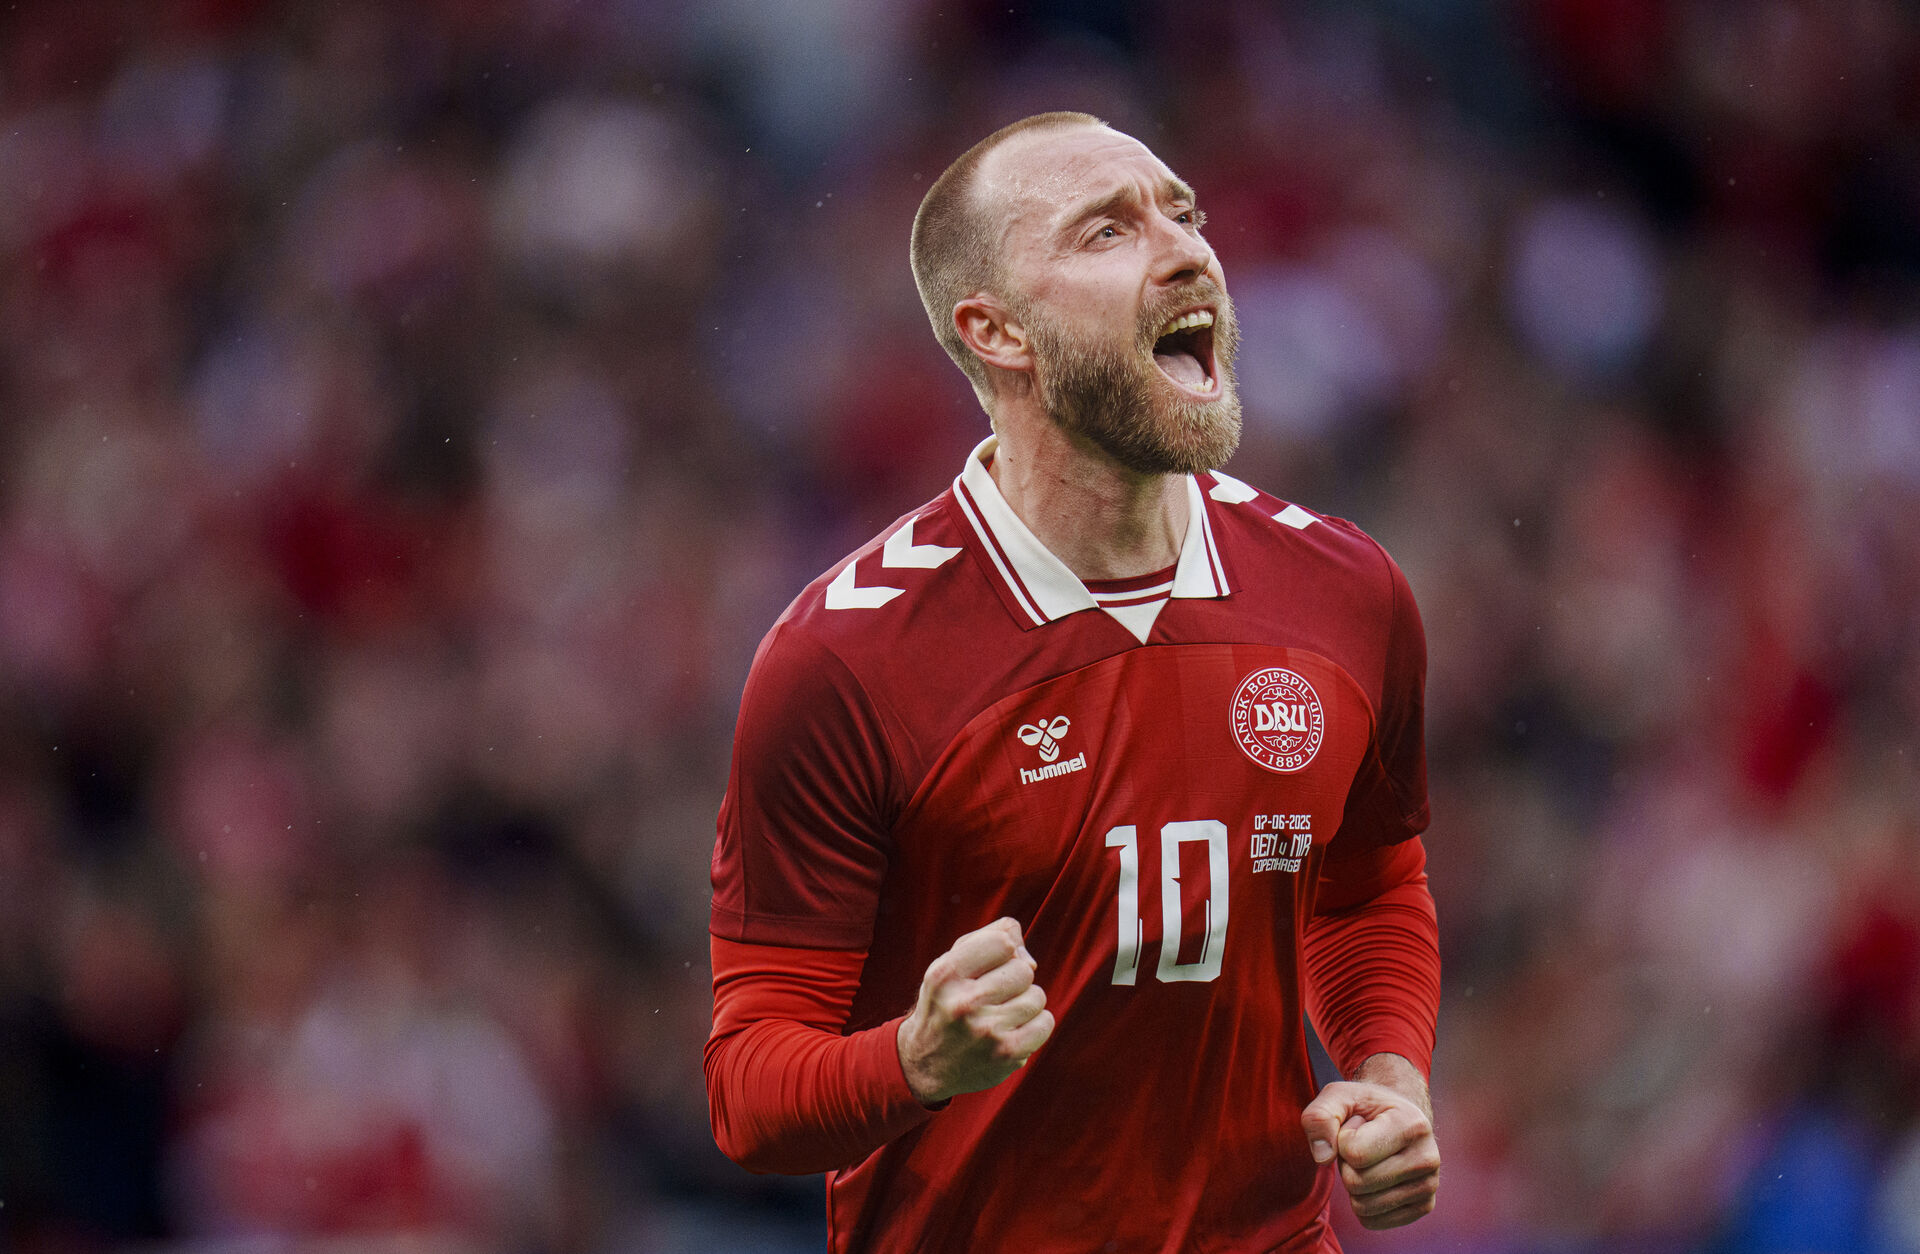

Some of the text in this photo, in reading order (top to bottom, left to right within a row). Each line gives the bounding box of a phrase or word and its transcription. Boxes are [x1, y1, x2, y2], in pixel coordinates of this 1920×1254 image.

[1236, 697, 1262, 756] DANSK
[1268, 754, 1303, 768] 1889
[1254, 702, 1308, 732] DBU
[1020, 752, 1087, 785] hummel
[1254, 814, 1312, 830] 07-06-2025
[1250, 833, 1279, 858] DEN
[1289, 833, 1312, 857] NIR
[1105, 819, 1229, 986] 10
